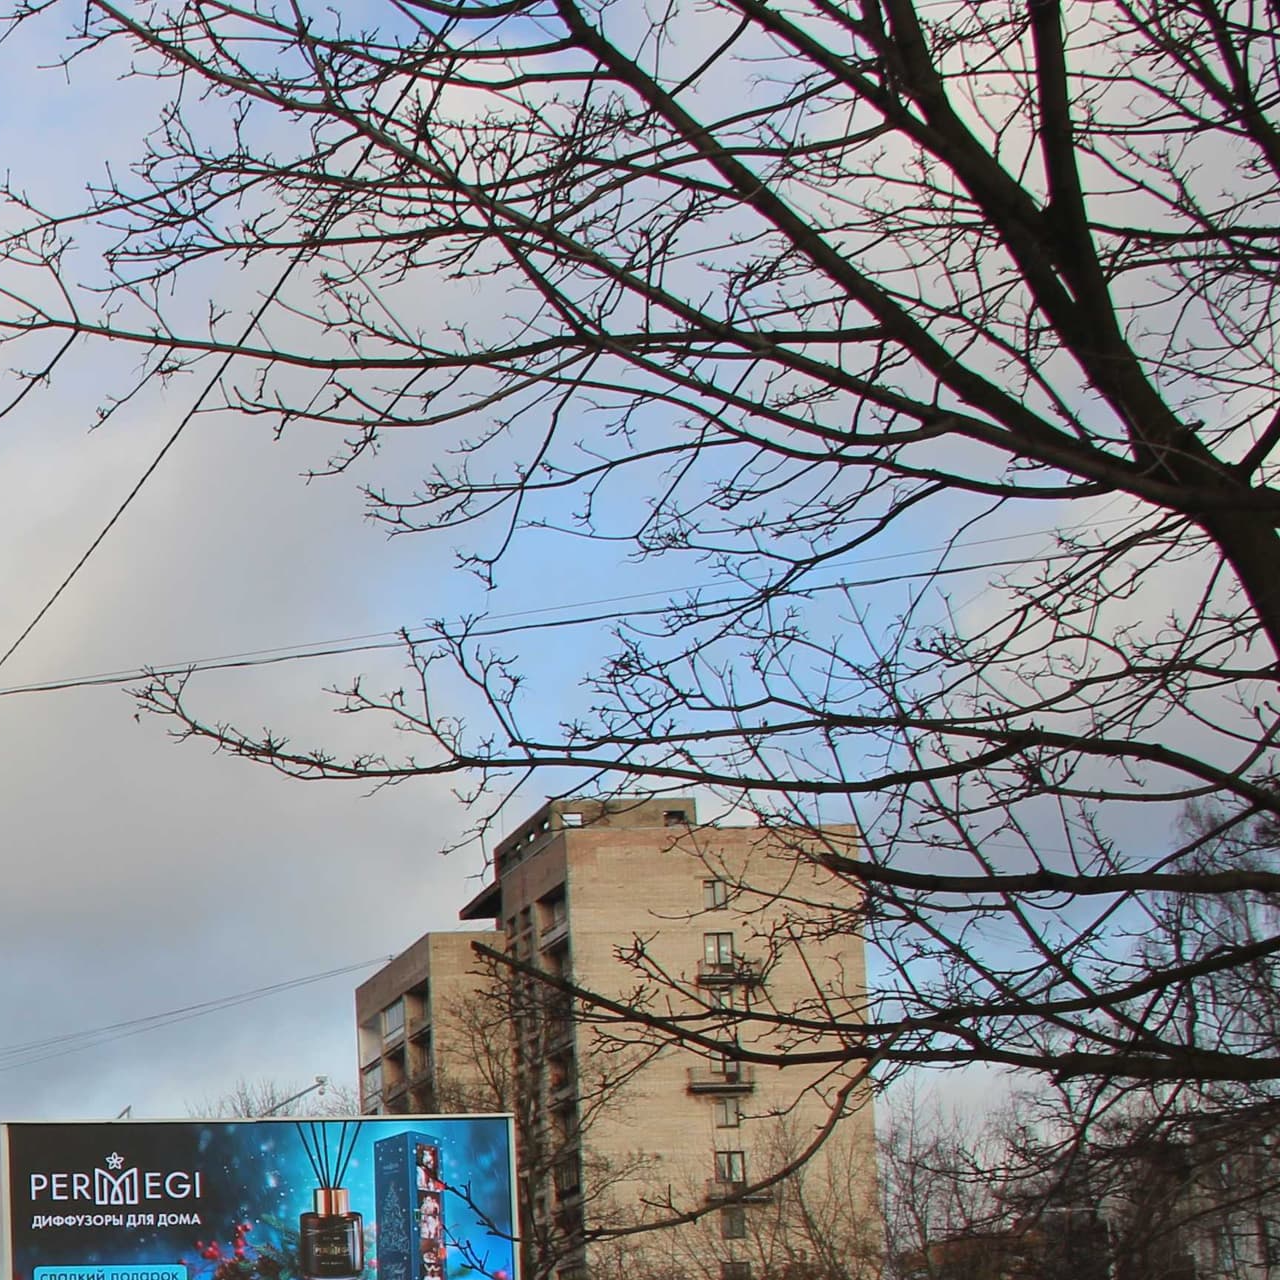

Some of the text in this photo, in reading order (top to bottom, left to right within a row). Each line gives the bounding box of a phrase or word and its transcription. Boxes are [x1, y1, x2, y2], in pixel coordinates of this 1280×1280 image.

[30, 1168, 201, 1206] PERMEGI
[32, 1213, 201, 1229] ДИФФУЗОРЫ ДЛЯ ДОМА
